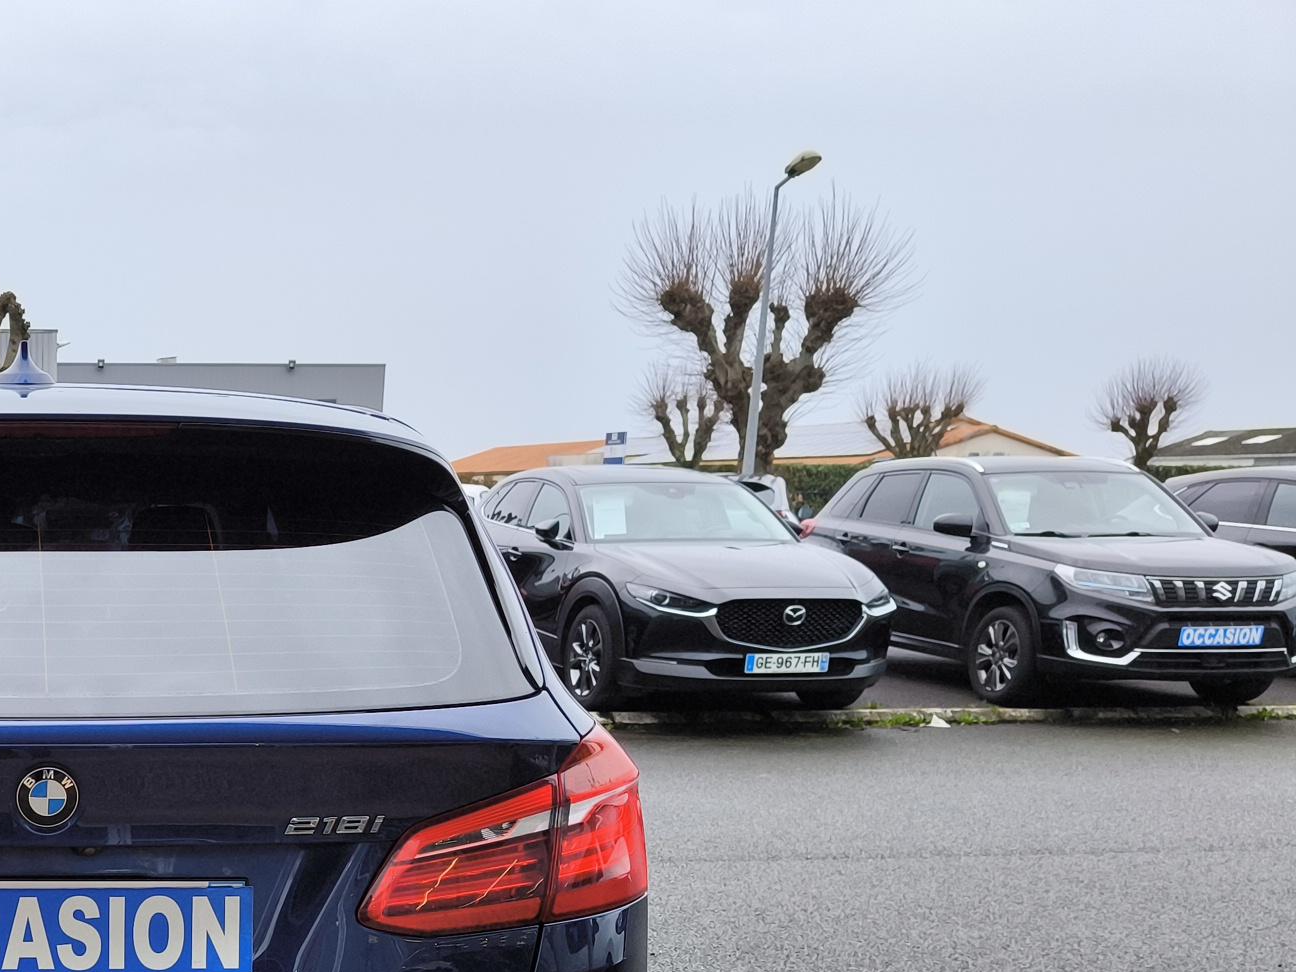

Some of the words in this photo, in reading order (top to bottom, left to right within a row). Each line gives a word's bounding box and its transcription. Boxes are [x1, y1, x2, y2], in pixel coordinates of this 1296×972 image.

[1182, 628, 1261, 645] OCCASION
[755, 656, 820, 669] GE-967-FH
[23, 769, 74, 789] BMW
[284, 815, 386, 835] 218i
